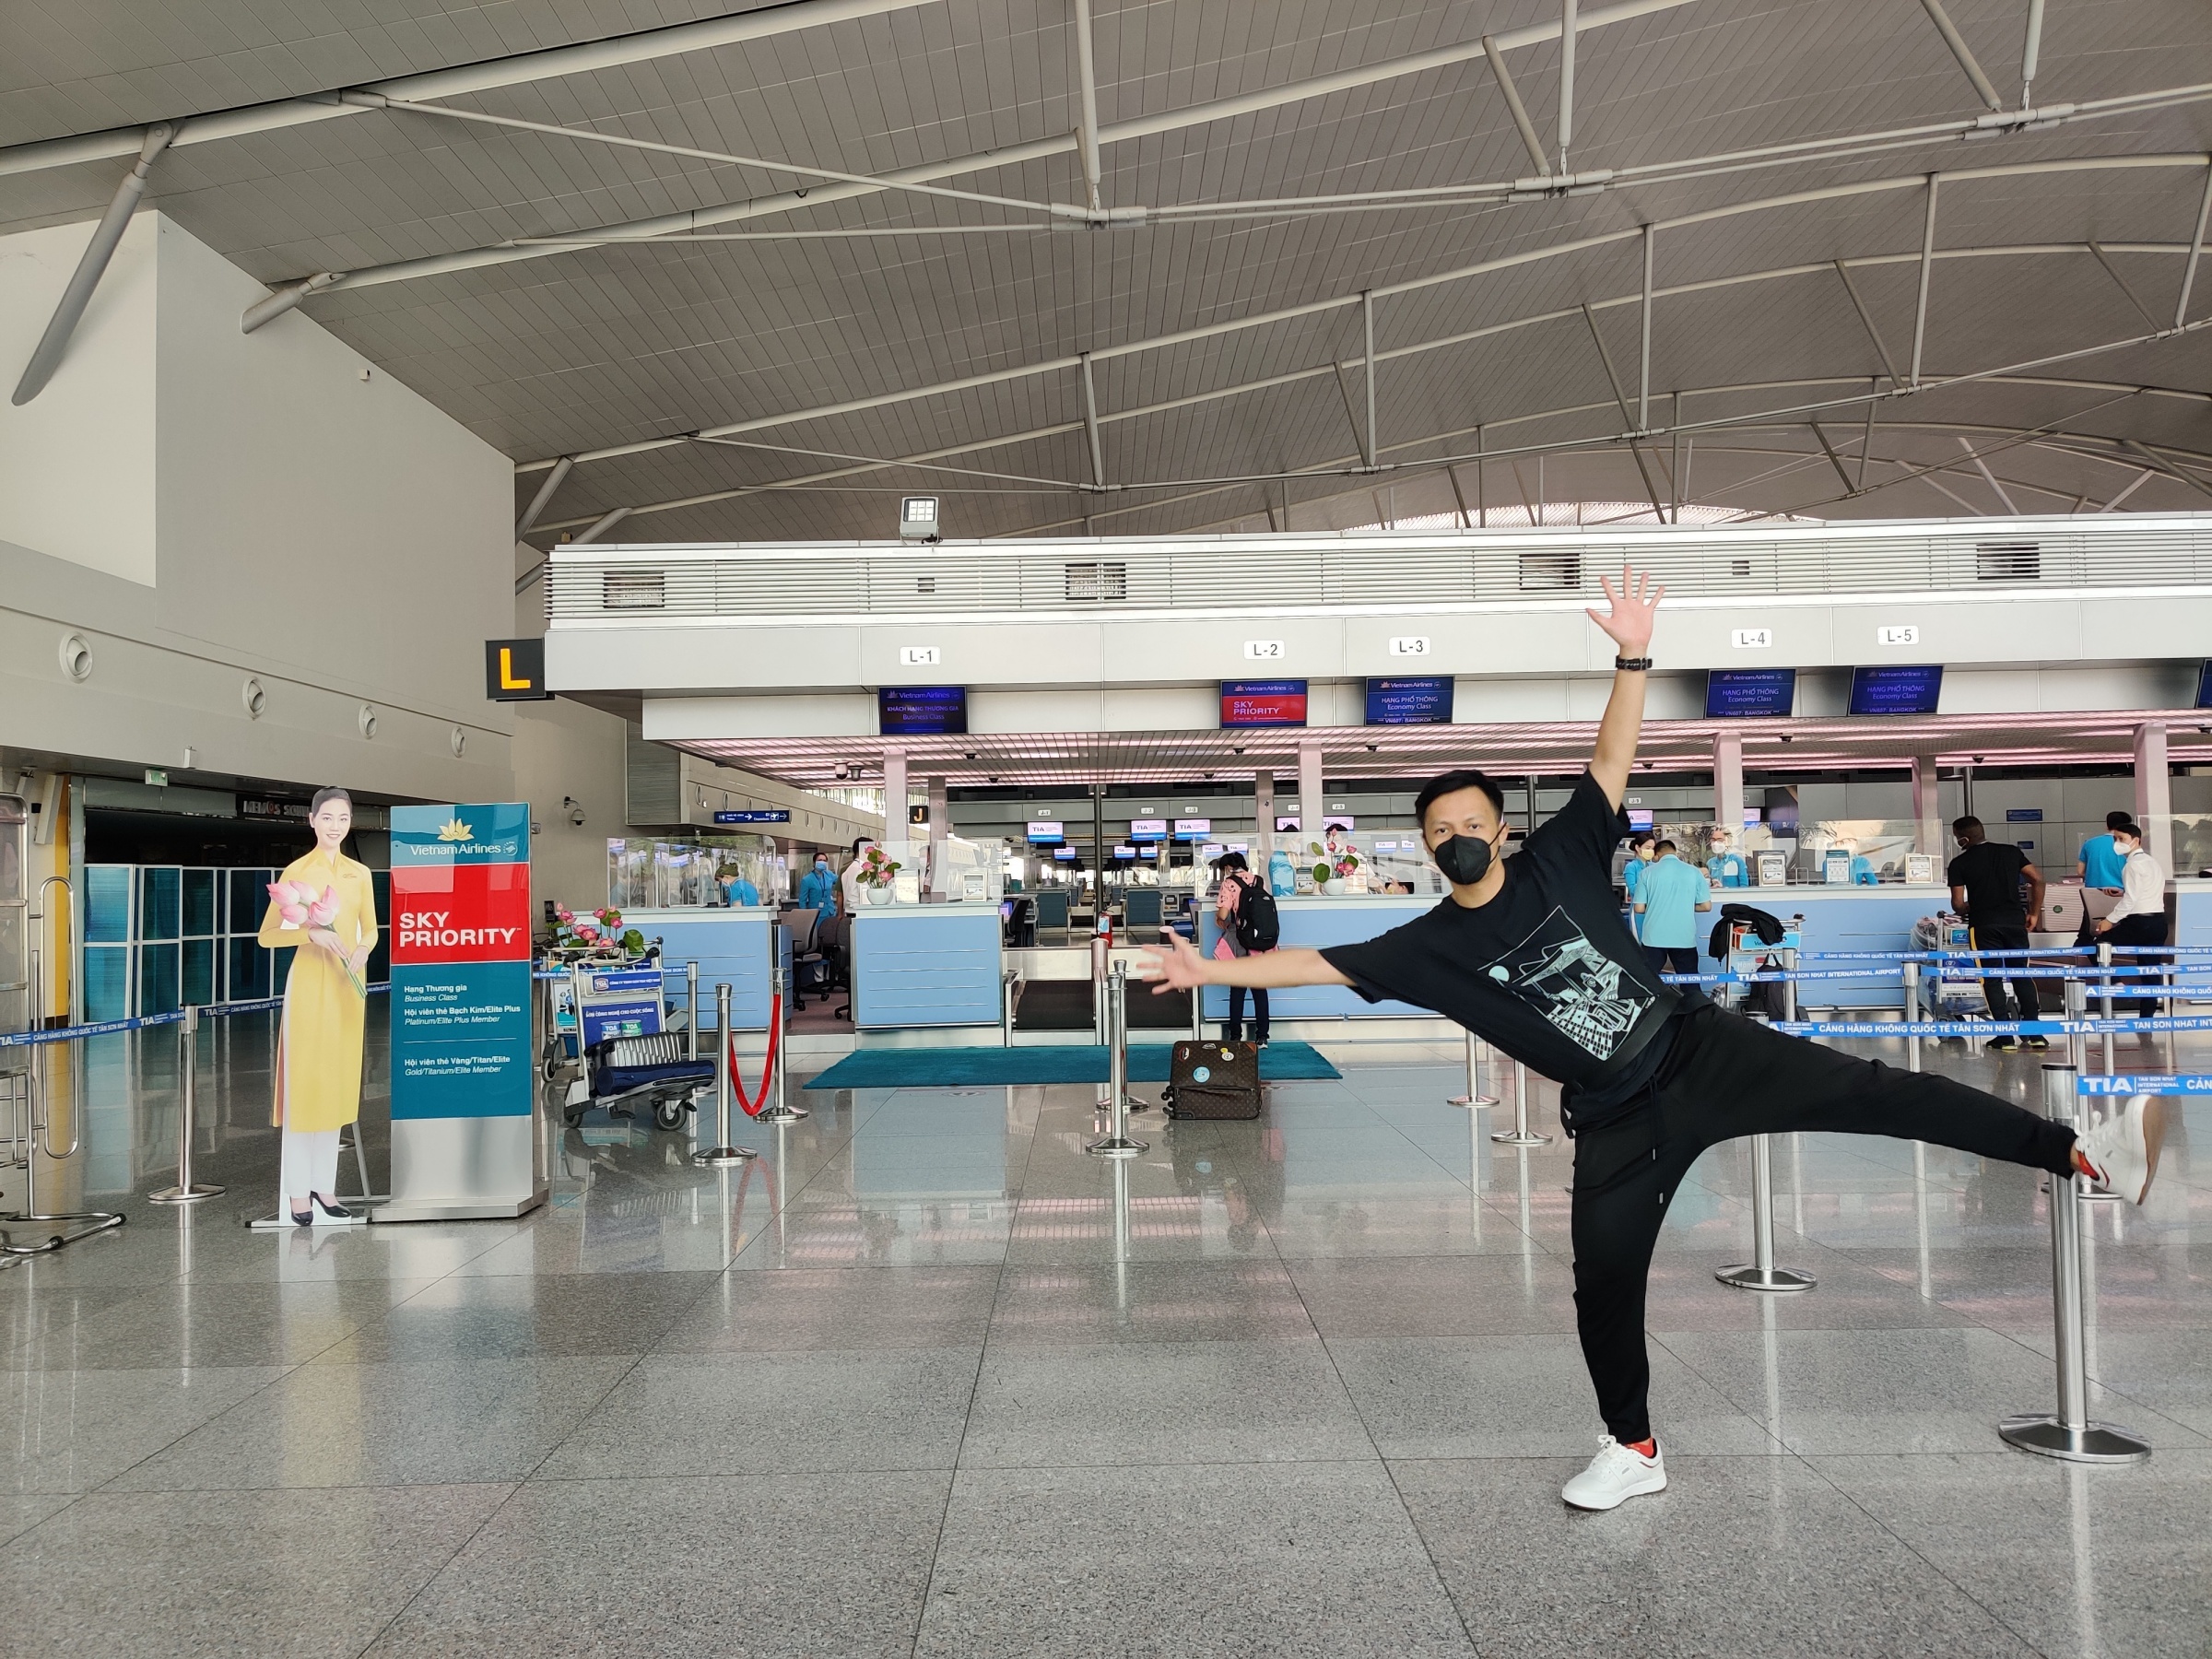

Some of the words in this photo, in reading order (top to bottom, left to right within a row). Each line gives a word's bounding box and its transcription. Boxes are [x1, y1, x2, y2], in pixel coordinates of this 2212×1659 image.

[1740, 631, 1766, 645] L-4
[1887, 629, 1912, 642] L-5
[1253, 643, 1278, 656] L-2
[1398, 640, 1424, 653] L-3
[910, 650, 932, 663] L-1
[500, 648, 531, 689] L
[1233, 707, 1280, 715] PRIORITY
[913, 807, 924, 822] J
[410, 844, 458, 855] Vietnam
[458, 843, 501, 854] Airlines
[399, 912, 450, 929] SKY
[399, 927, 516, 947] PRIORITY
[1736, 973, 1759, 982] TIA
[1828, 970, 1874, 978] INTERNATIONAL
[1937, 968, 1961, 976] TIA
[2136, 966, 2160, 974] TIA
[404, 985, 424, 994] Hạng
[455, 984, 467, 993] gia
[2132, 985, 2151, 994] CẢNG
[2152, 985, 2171, 994] HÀNG
[2172, 985, 2195, 994] KHÔNG
[205, 1008, 218, 1017] TIA
[404, 1008, 417, 1017] Hội
[418, 1007, 434, 1016] viên
[449, 1006, 468, 1016] Bạch
[469, 1005, 503, 1014] Kim/Elite
[504, 1005, 521, 1013] Plus
[405, 1017, 453, 1025] Platinum/Elite
[453, 1016, 469, 1024] Plus
[2134, 1020, 2150, 1030] TAN
[2153, 1020, 2171, 1029] SON
[2173, 1019, 2196, 1029] NHAT
[0, 1036, 14, 1046] IA
[47, 1031, 61, 1040] HÀNG
[62, 1029, 78, 1037] KHÔNG
[78, 1026, 91, 1035] QUỐC
[139, 1016, 156, 1026] TIA
[1818, 1022, 1844, 1033] CẢNG
[1846, 1023, 1874, 1033] HÀNG
[1875, 1023, 1908, 1033] KHÔNG
[1910, 1023, 1936, 1033] QUỐC
[1938, 1023, 1951, 1032] TẾ
[1952, 1023, 1971, 1032] TÂN
[1972, 1024, 1994, 1032] SƠN
[1994, 1022, 2020, 1032] NHẤT
[2059, 1021, 2095, 1033] TIA
[404, 1059, 418, 1067] Hội
[450, 1055, 511, 1065] Vàng/Titan/Elite
[405, 1066, 471, 1077] Gold/Titanium/Elite
[472, 1065, 501, 1074] Member
[2083, 1077, 2133, 1093] TIA
